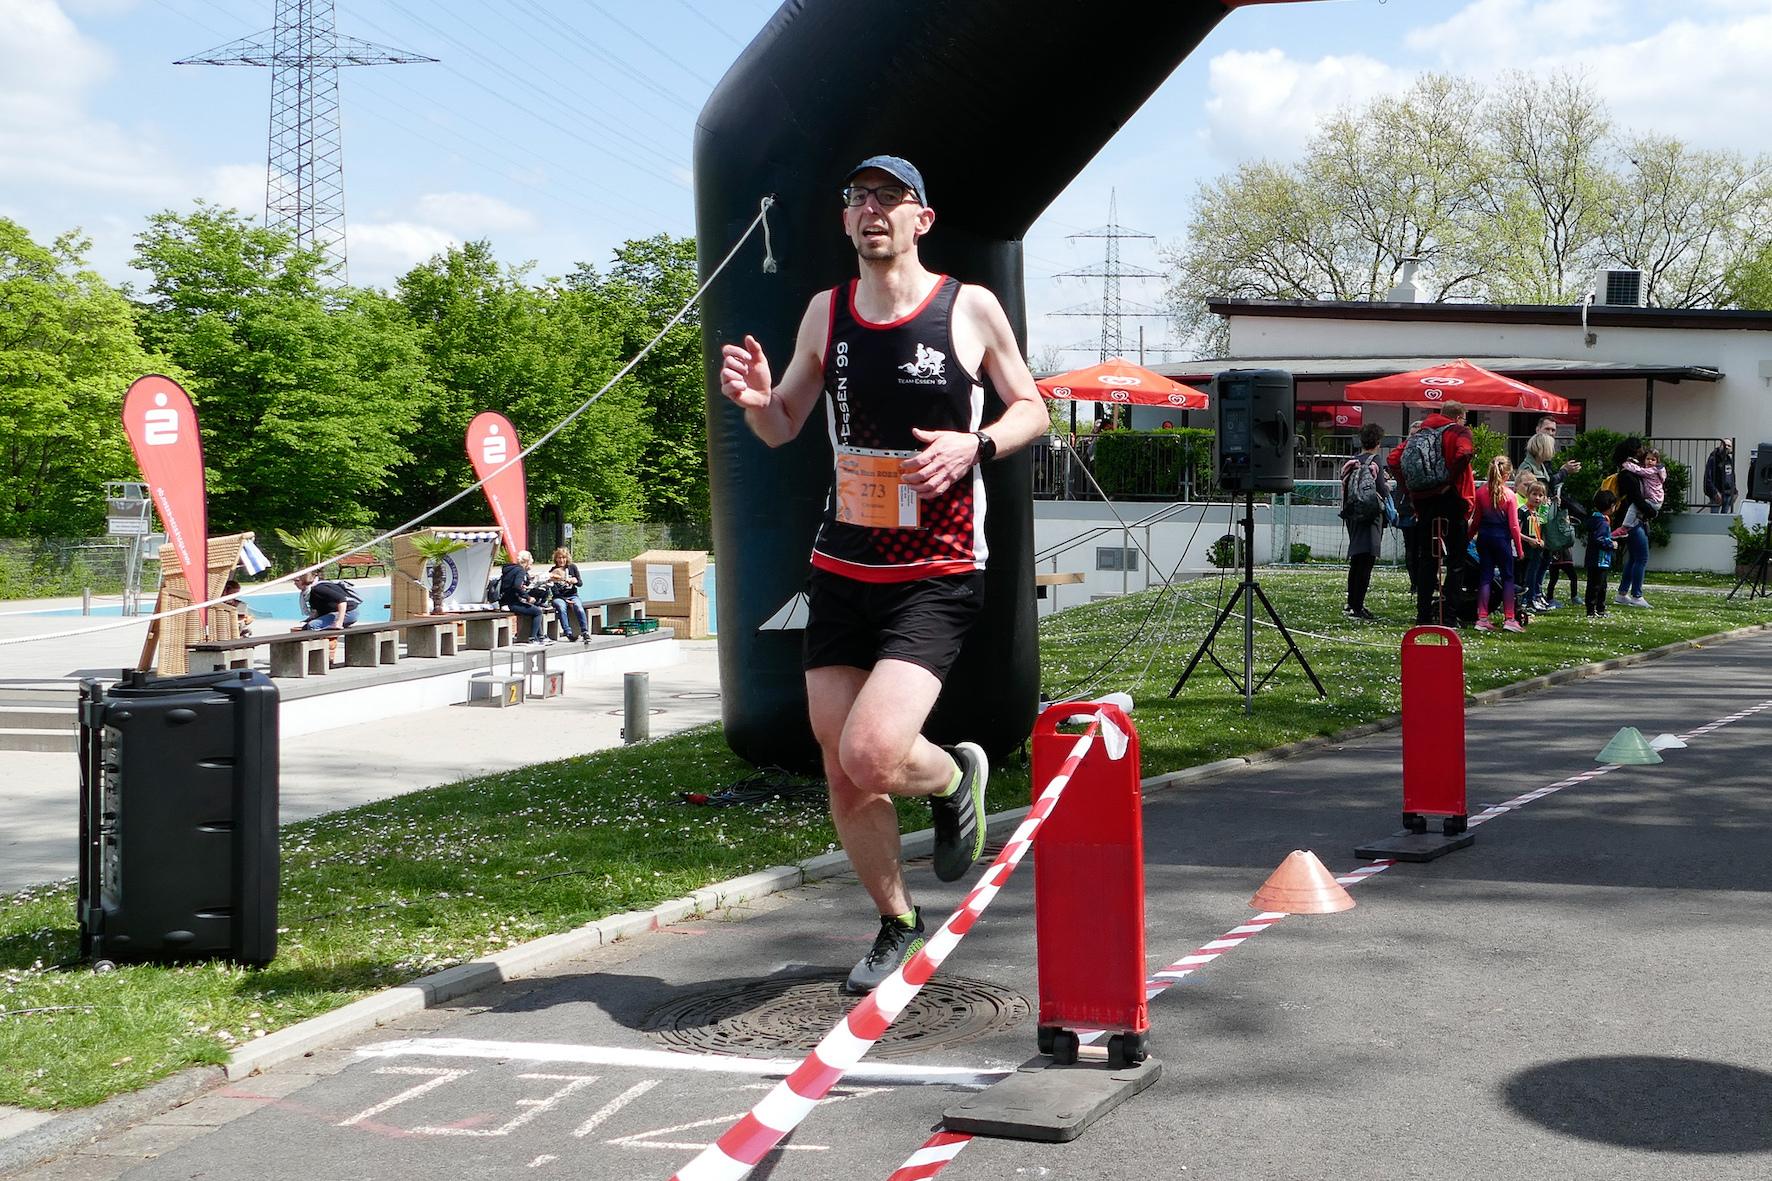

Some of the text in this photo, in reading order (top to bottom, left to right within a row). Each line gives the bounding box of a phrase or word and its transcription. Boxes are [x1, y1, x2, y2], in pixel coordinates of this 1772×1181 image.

[861, 483, 886, 498] 273
[531, 653, 539, 672] 1
[509, 684, 518, 703] 2
